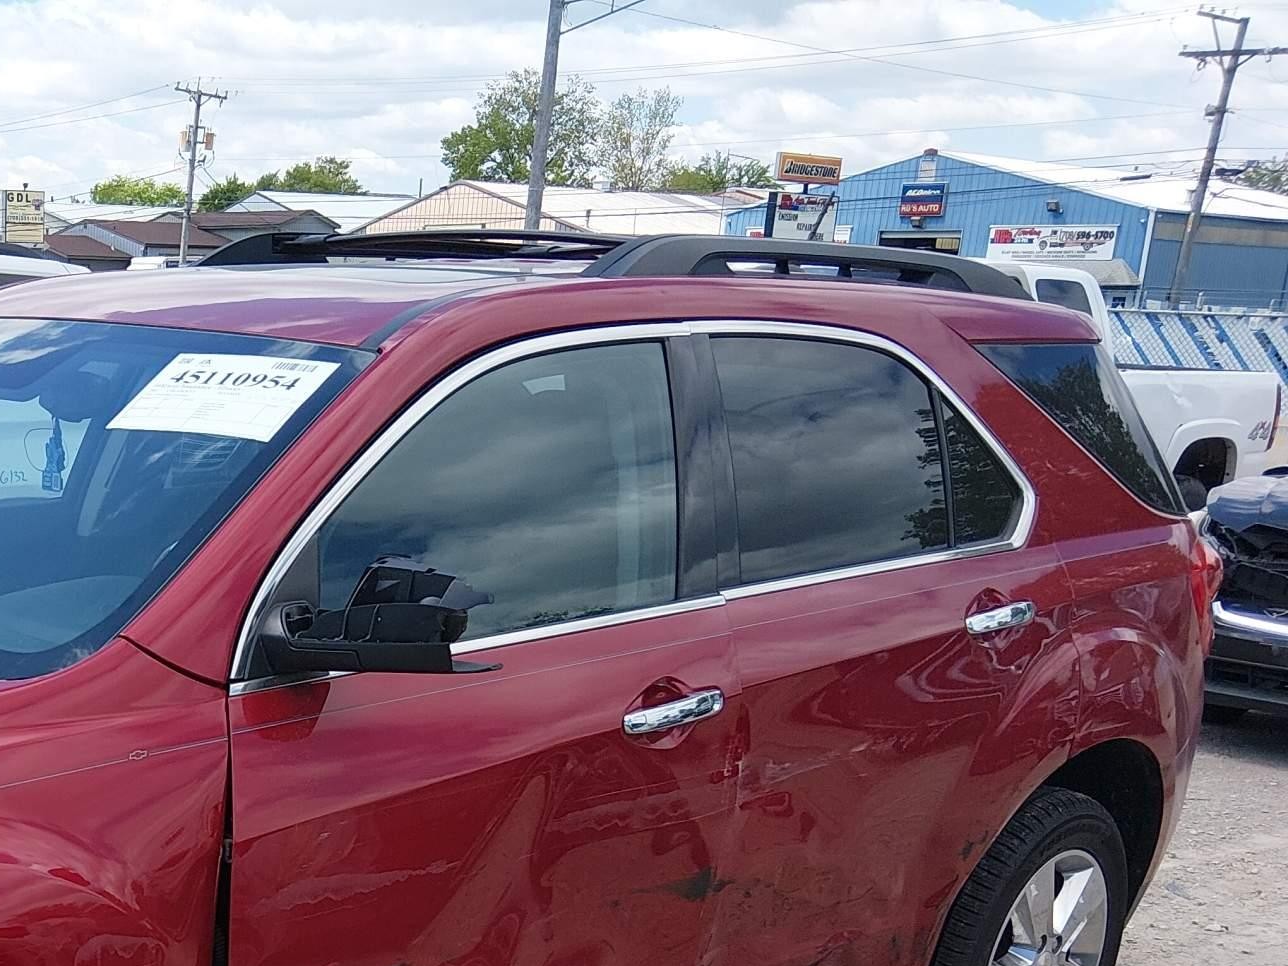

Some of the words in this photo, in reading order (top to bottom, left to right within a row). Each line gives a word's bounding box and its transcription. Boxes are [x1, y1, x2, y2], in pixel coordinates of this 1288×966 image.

[784, 160, 838, 178] BRIDGESTONE
[7, 192, 31, 203] GDL
[918, 204, 939, 212] AUTO
[170, 369, 302, 391] 45110954
